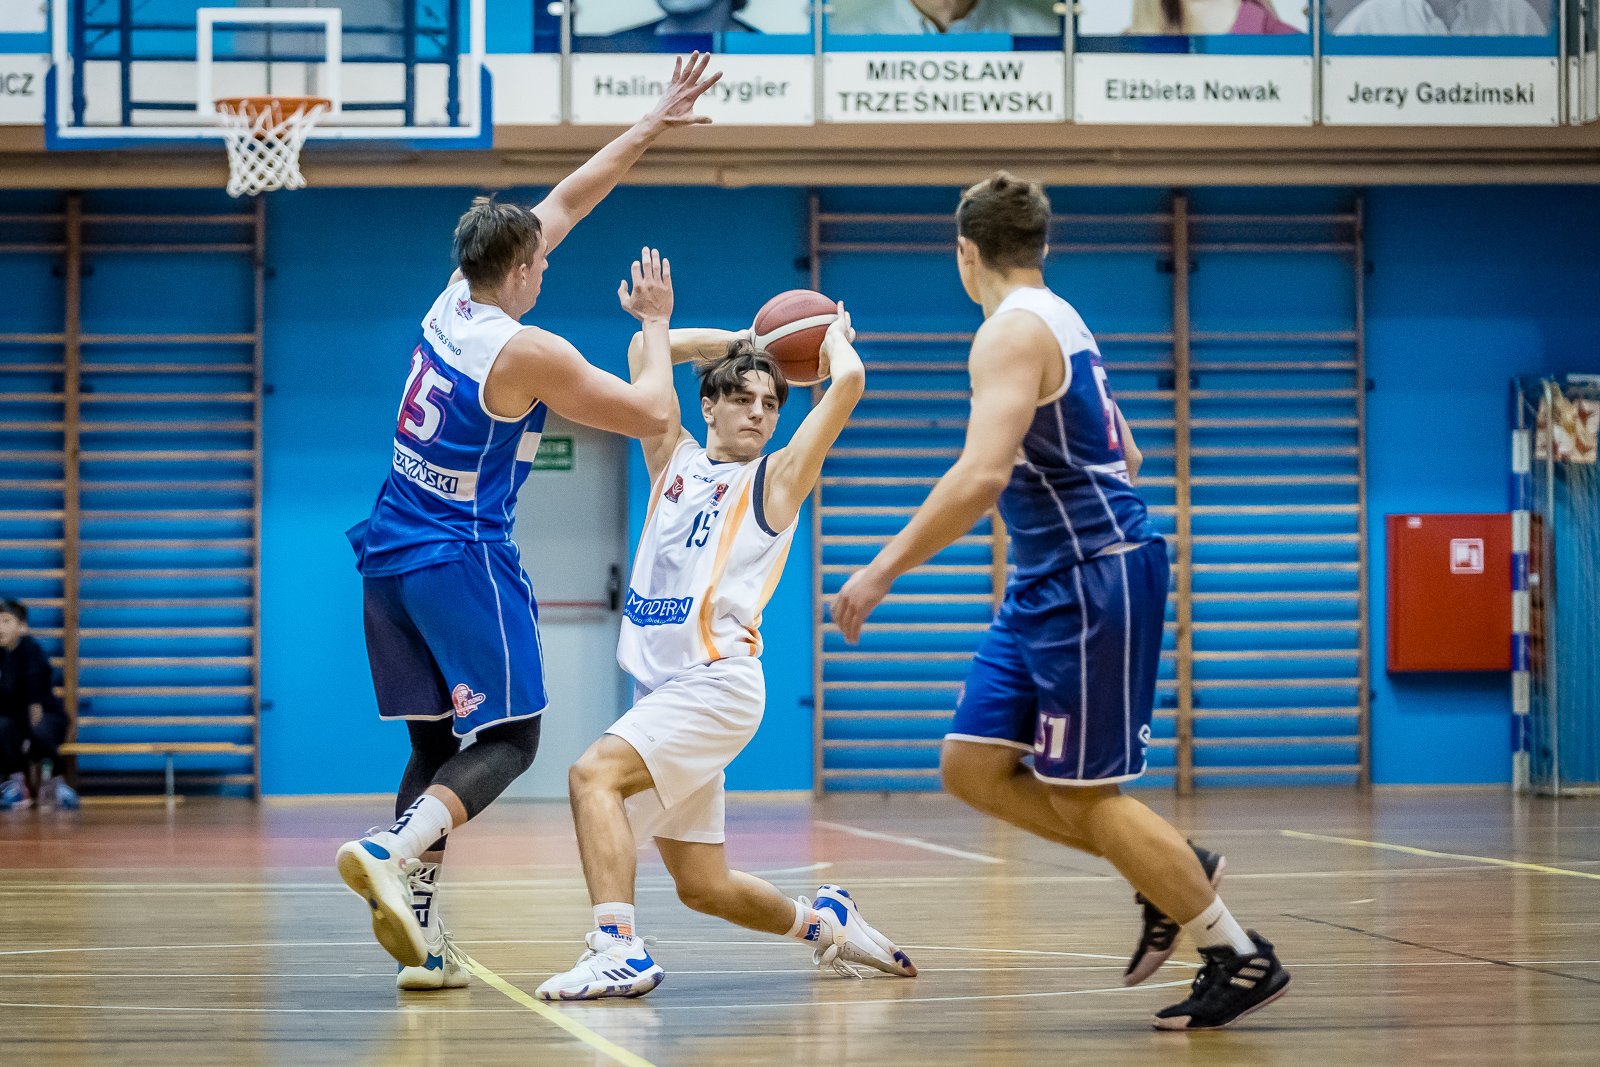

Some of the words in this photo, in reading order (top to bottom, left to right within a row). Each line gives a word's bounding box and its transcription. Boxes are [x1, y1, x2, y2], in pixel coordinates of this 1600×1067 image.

[867, 60, 1024, 81] MIROSŁAW
[593, 75, 664, 97] Halin
[1105, 78, 1196, 101] Elżbieta
[1203, 79, 1281, 101] Nowak
[1347, 80, 1408, 110] Jerzy
[1415, 81, 1536, 105] Gadzimski
[838, 86, 1053, 112] TRZEŚNIEWSKI
[397, 347, 455, 443] 15
[686, 510, 720, 547] 15
[627, 592, 691, 616] MODERN
